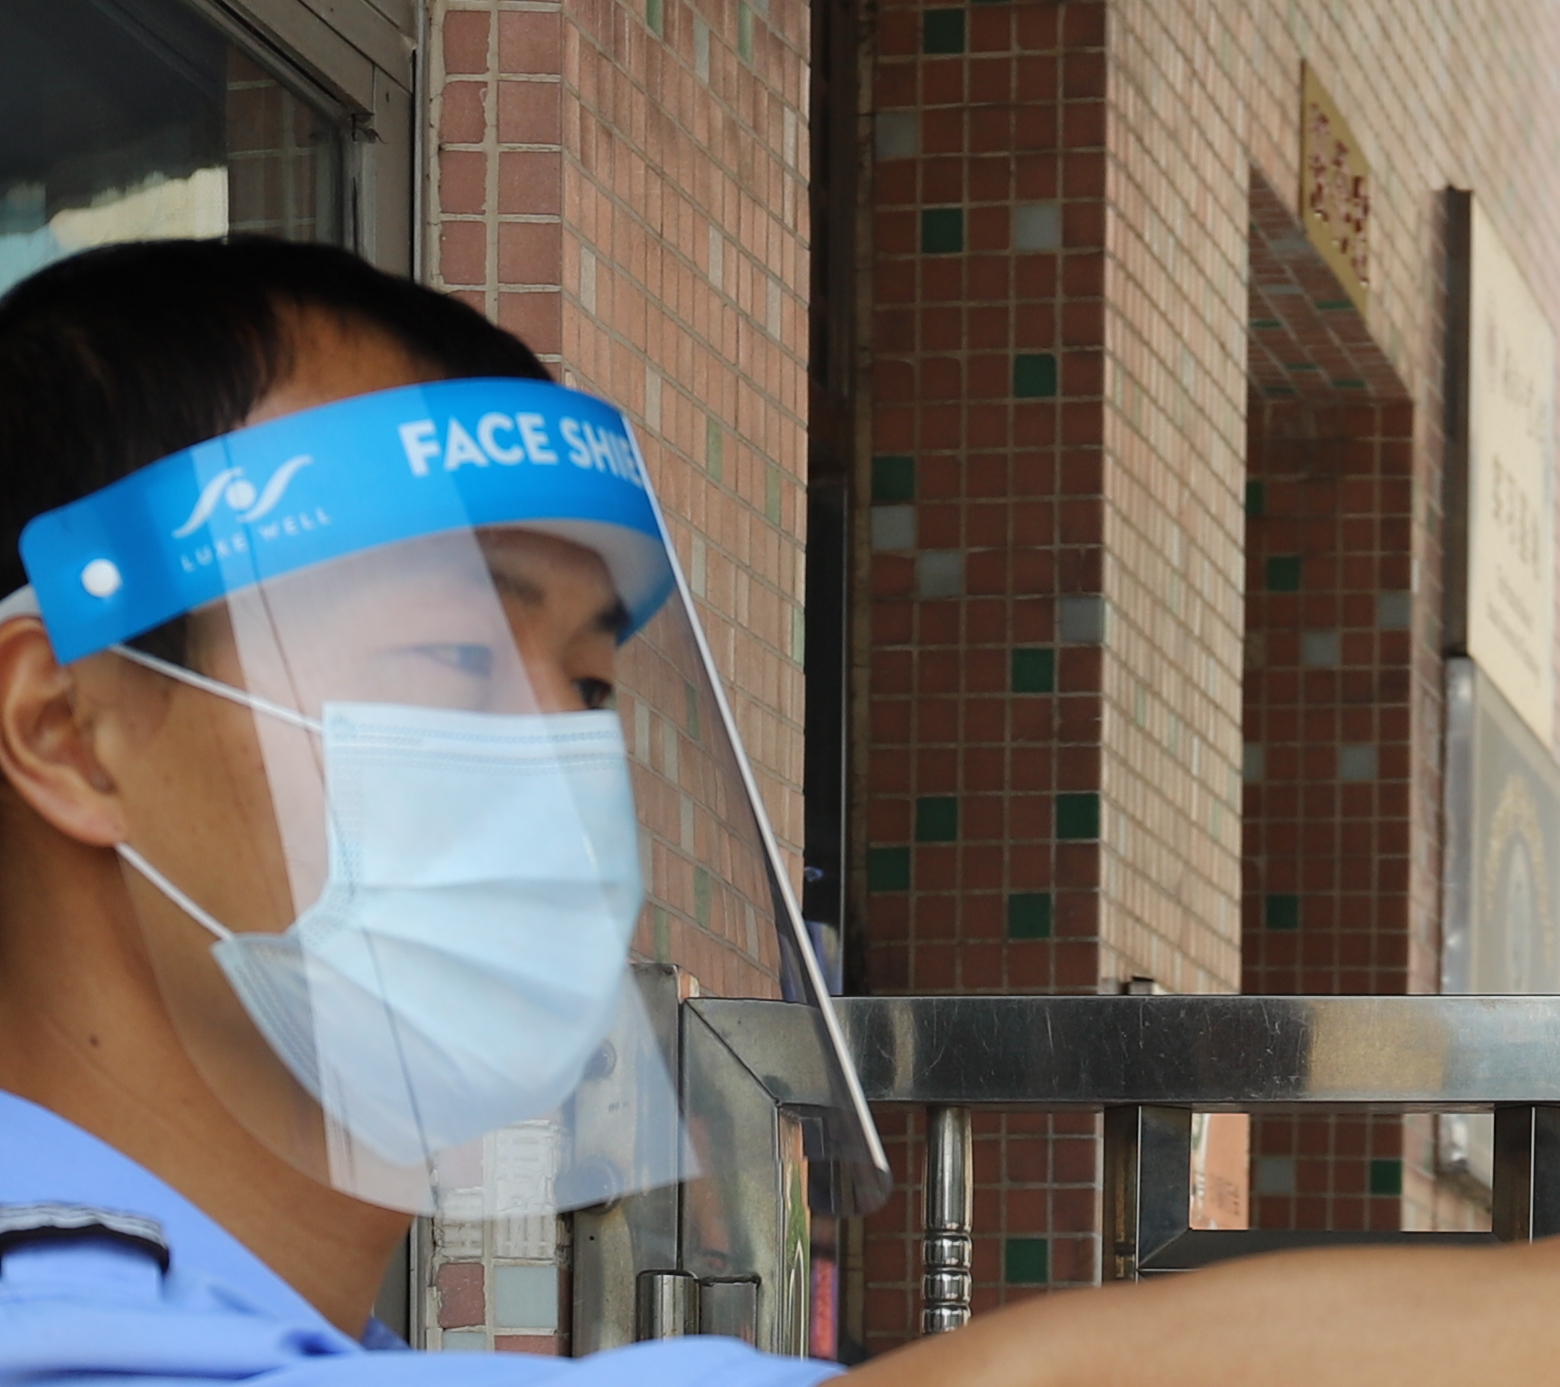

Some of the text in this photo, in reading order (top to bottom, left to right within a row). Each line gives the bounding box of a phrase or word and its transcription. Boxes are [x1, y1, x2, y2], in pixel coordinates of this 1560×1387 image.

[397, 411, 559, 478] FACE
[179, 506, 332, 573] LUXE WELL
